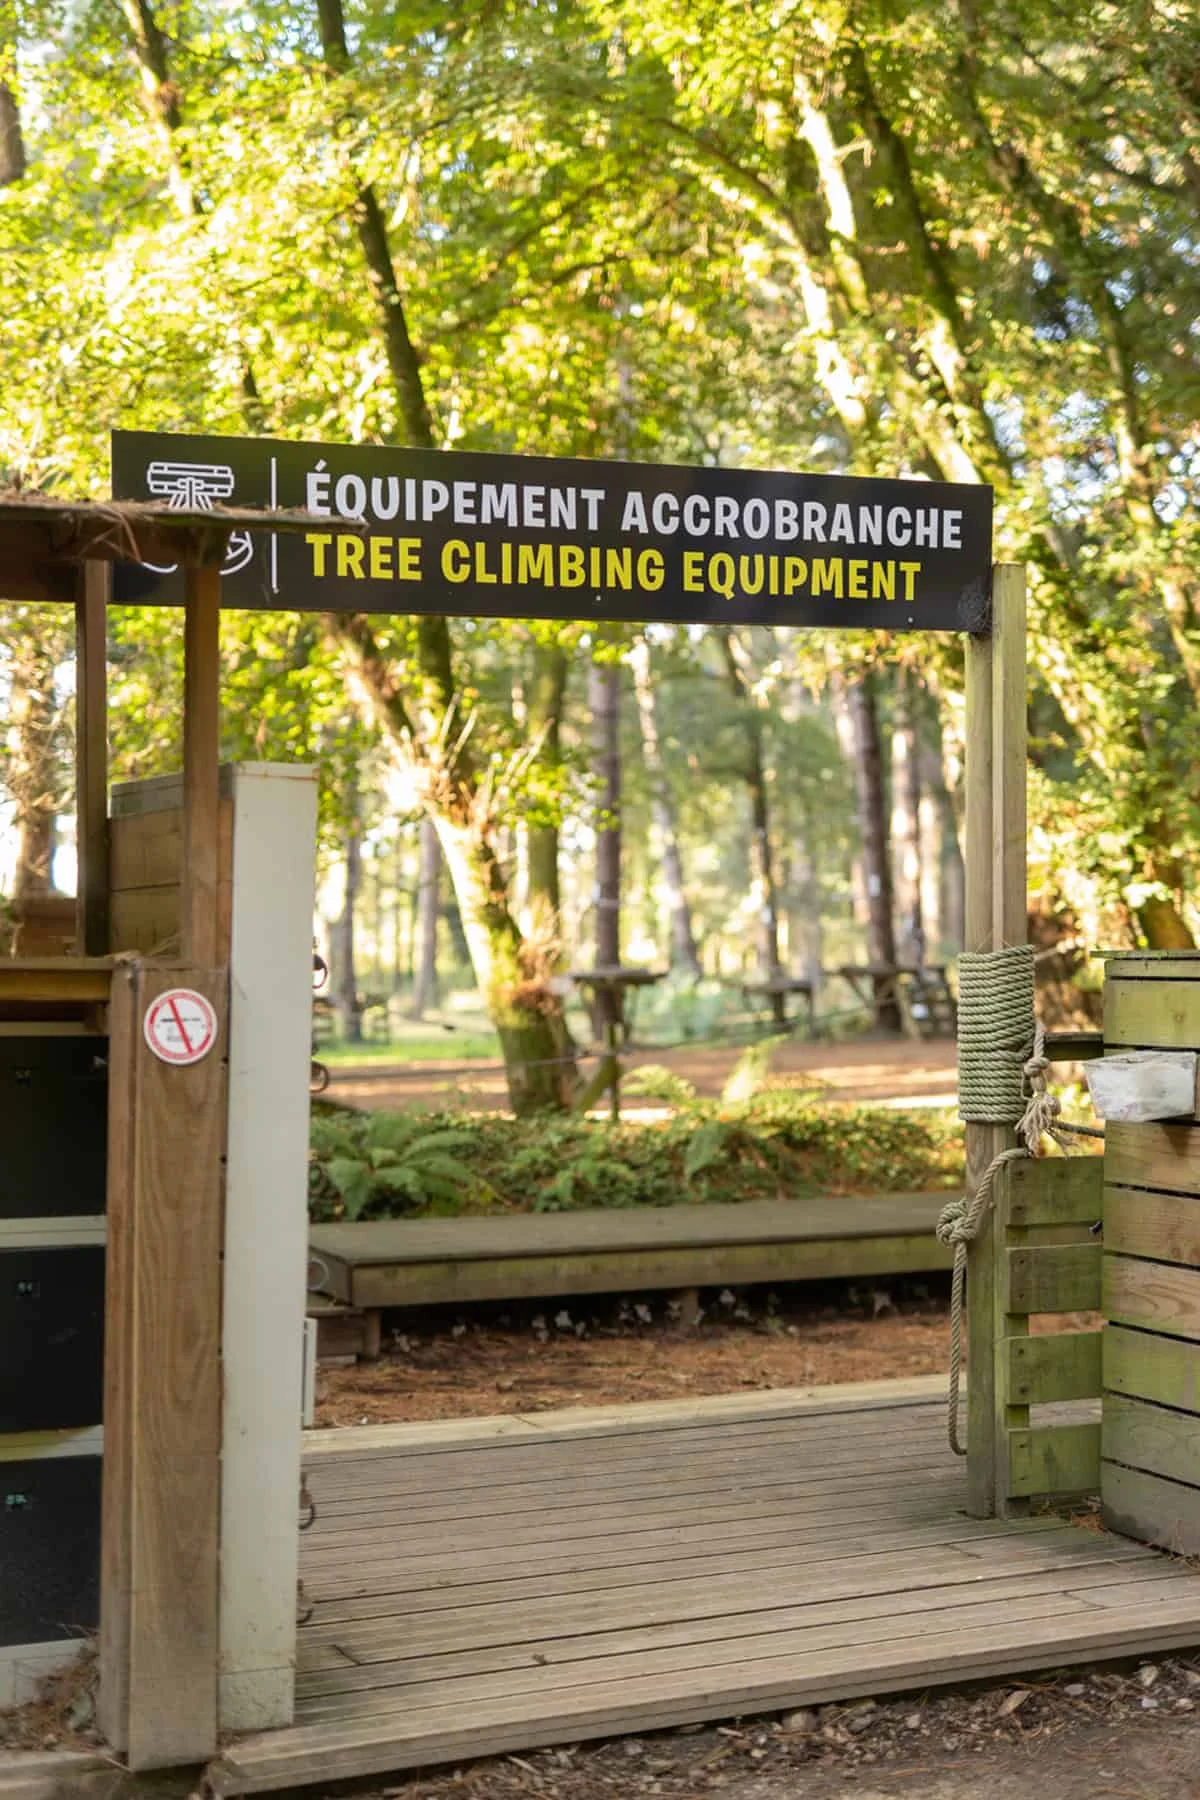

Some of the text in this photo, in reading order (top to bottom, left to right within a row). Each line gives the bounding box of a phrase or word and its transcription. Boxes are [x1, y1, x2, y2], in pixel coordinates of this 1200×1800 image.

[305, 459, 963, 549] ÉQUIPEMENT ACCROBRANCHE
[305, 532, 921, 601] TREE CLIMBING EQUIPMENT
